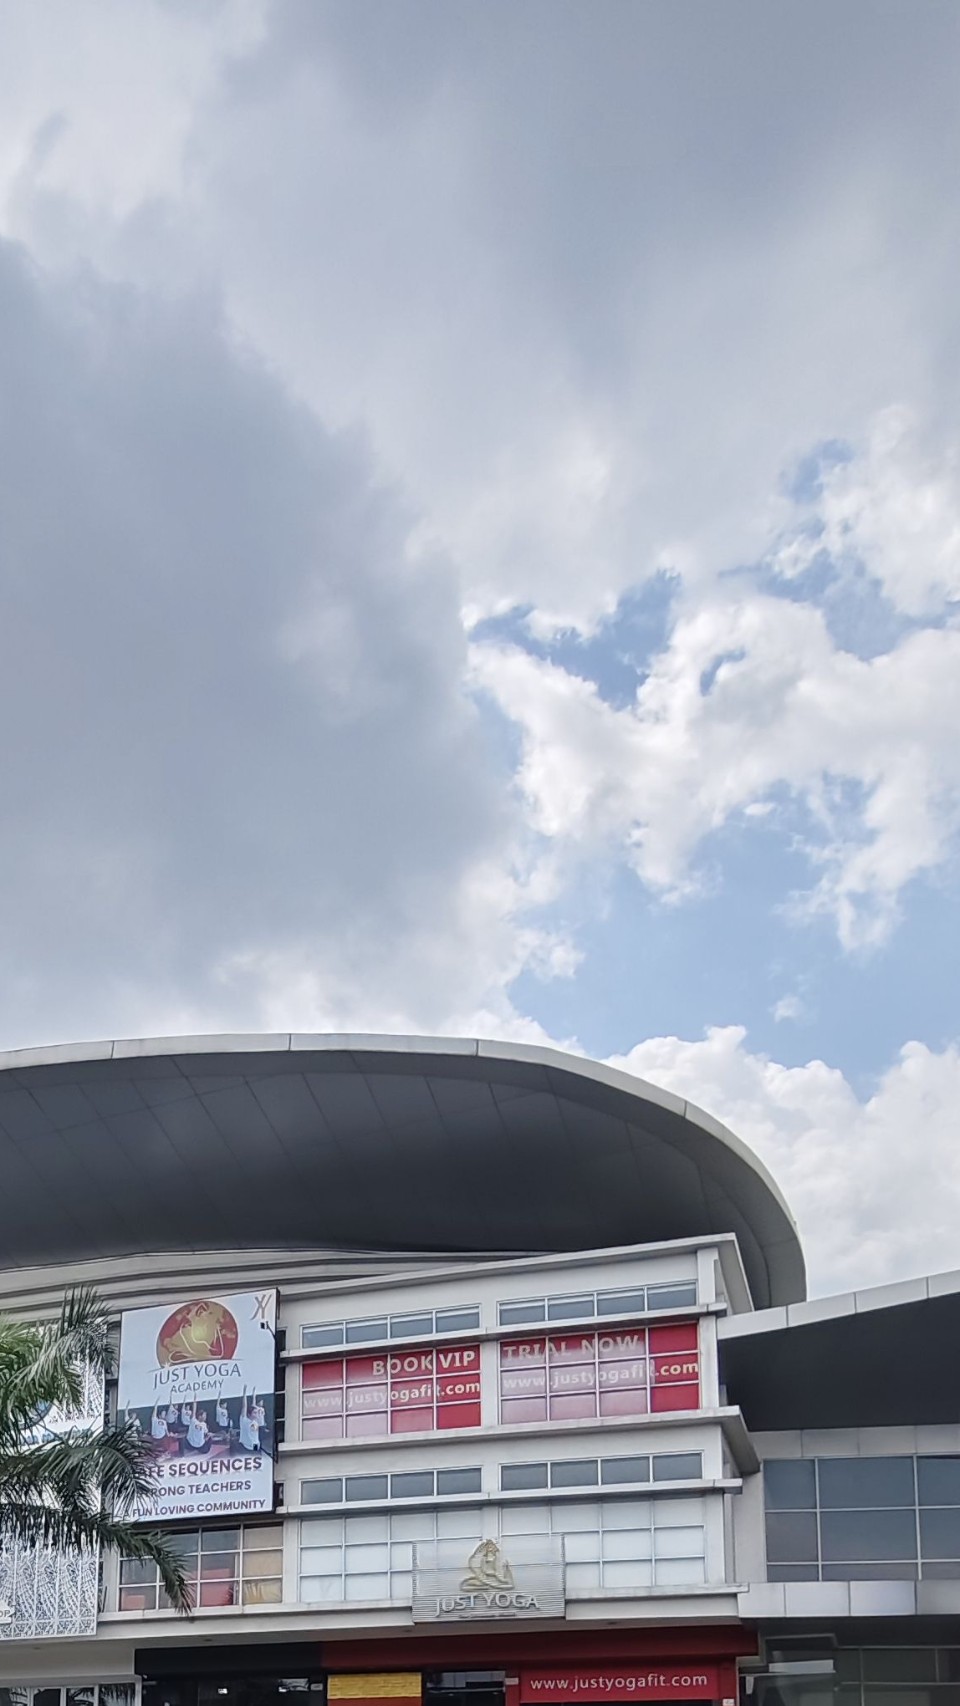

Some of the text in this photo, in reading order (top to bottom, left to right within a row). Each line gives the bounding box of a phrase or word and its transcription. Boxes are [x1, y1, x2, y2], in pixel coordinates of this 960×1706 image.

[502, 1334, 640, 1362] TRIAL NOW
[371, 1350, 476, 1376] BOOK VIP
[154, 1362, 241, 1389] JUST YOGA
[170, 1379, 225, 1394] ACADEMY
[502, 1361, 700, 1390] www.justyogafit.com
[303, 1380, 481, 1409] www.justyogafit.com
[168, 1456, 263, 1478] SEQUENCES
[188, 1480, 252, 1495] TEACHERS
[132, 1507, 153, 1518] FUN
[155, 1504, 195, 1516] LOVING
[196, 1499, 266, 1513] COMMUNITY
[435, 1593, 540, 1617] JUST YOGA
[530, 1673, 708, 1693] www.justyogafit.com
